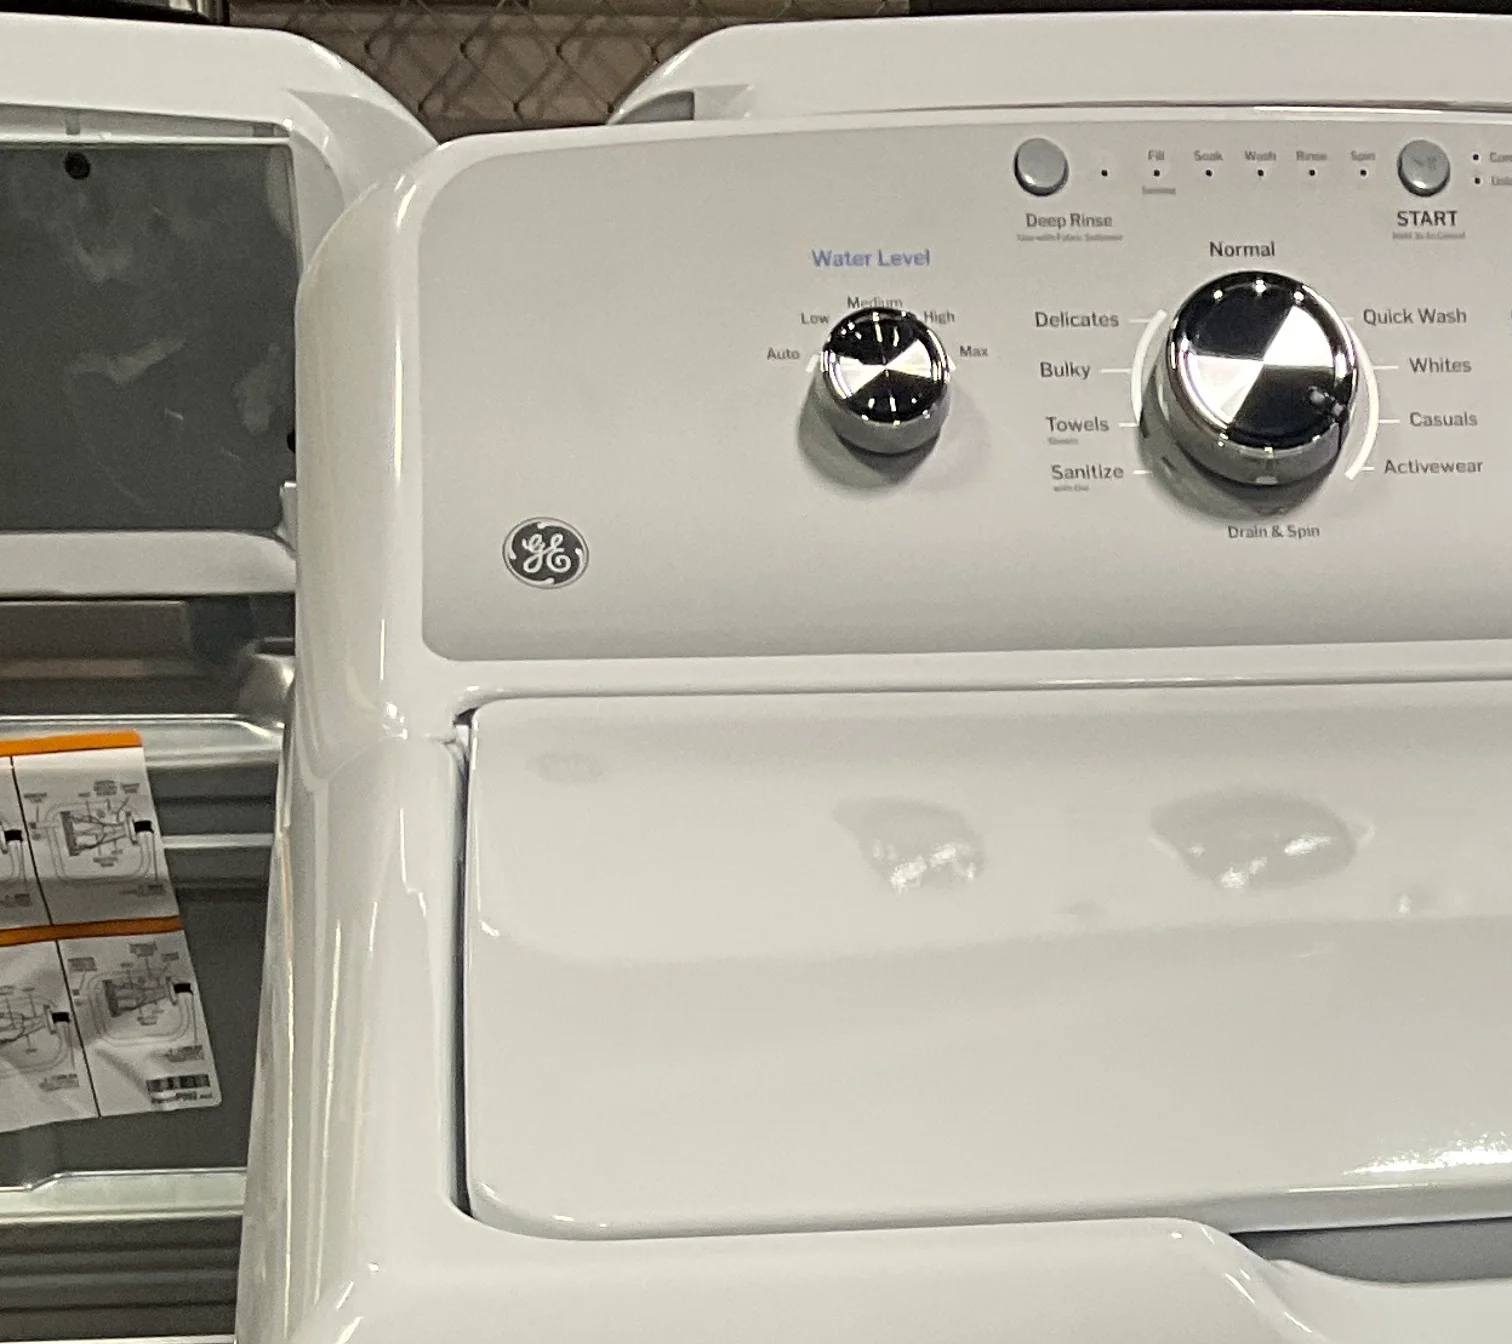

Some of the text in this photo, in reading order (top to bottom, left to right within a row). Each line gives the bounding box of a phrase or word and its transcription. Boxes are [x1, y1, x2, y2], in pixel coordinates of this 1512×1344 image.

[1148, 150, 1165, 162] Fill
[1193, 150, 1223, 162] Soak
[1244, 150, 1277, 162] Wash
[1025, 212, 1112, 230] Deep Rinse
[1397, 210, 1458, 227] START
[1209, 241, 1275, 258] Normal
[811, 249, 931, 267] Water Level
[847, 295, 903, 308] Medium
[801, 312, 829, 325] Low
[924, 310, 955, 324] High
[1035, 311, 1119, 328] Delicates
[1363, 308, 1467, 325] Quick Wash
[766, 347, 800, 361] Auto
[960, 344, 988, 358] Max
[1040, 361, 1090, 380] Bulky
[1409, 358, 1472, 373] Whites
[1046, 416, 1109, 432] Towels
[1409, 411, 1477, 427] Casuals
[1051, 464, 1124, 480] Sanitize
[1384, 459, 1483, 474] Activewear
[1228, 525, 1320, 541] Drain & Spin
